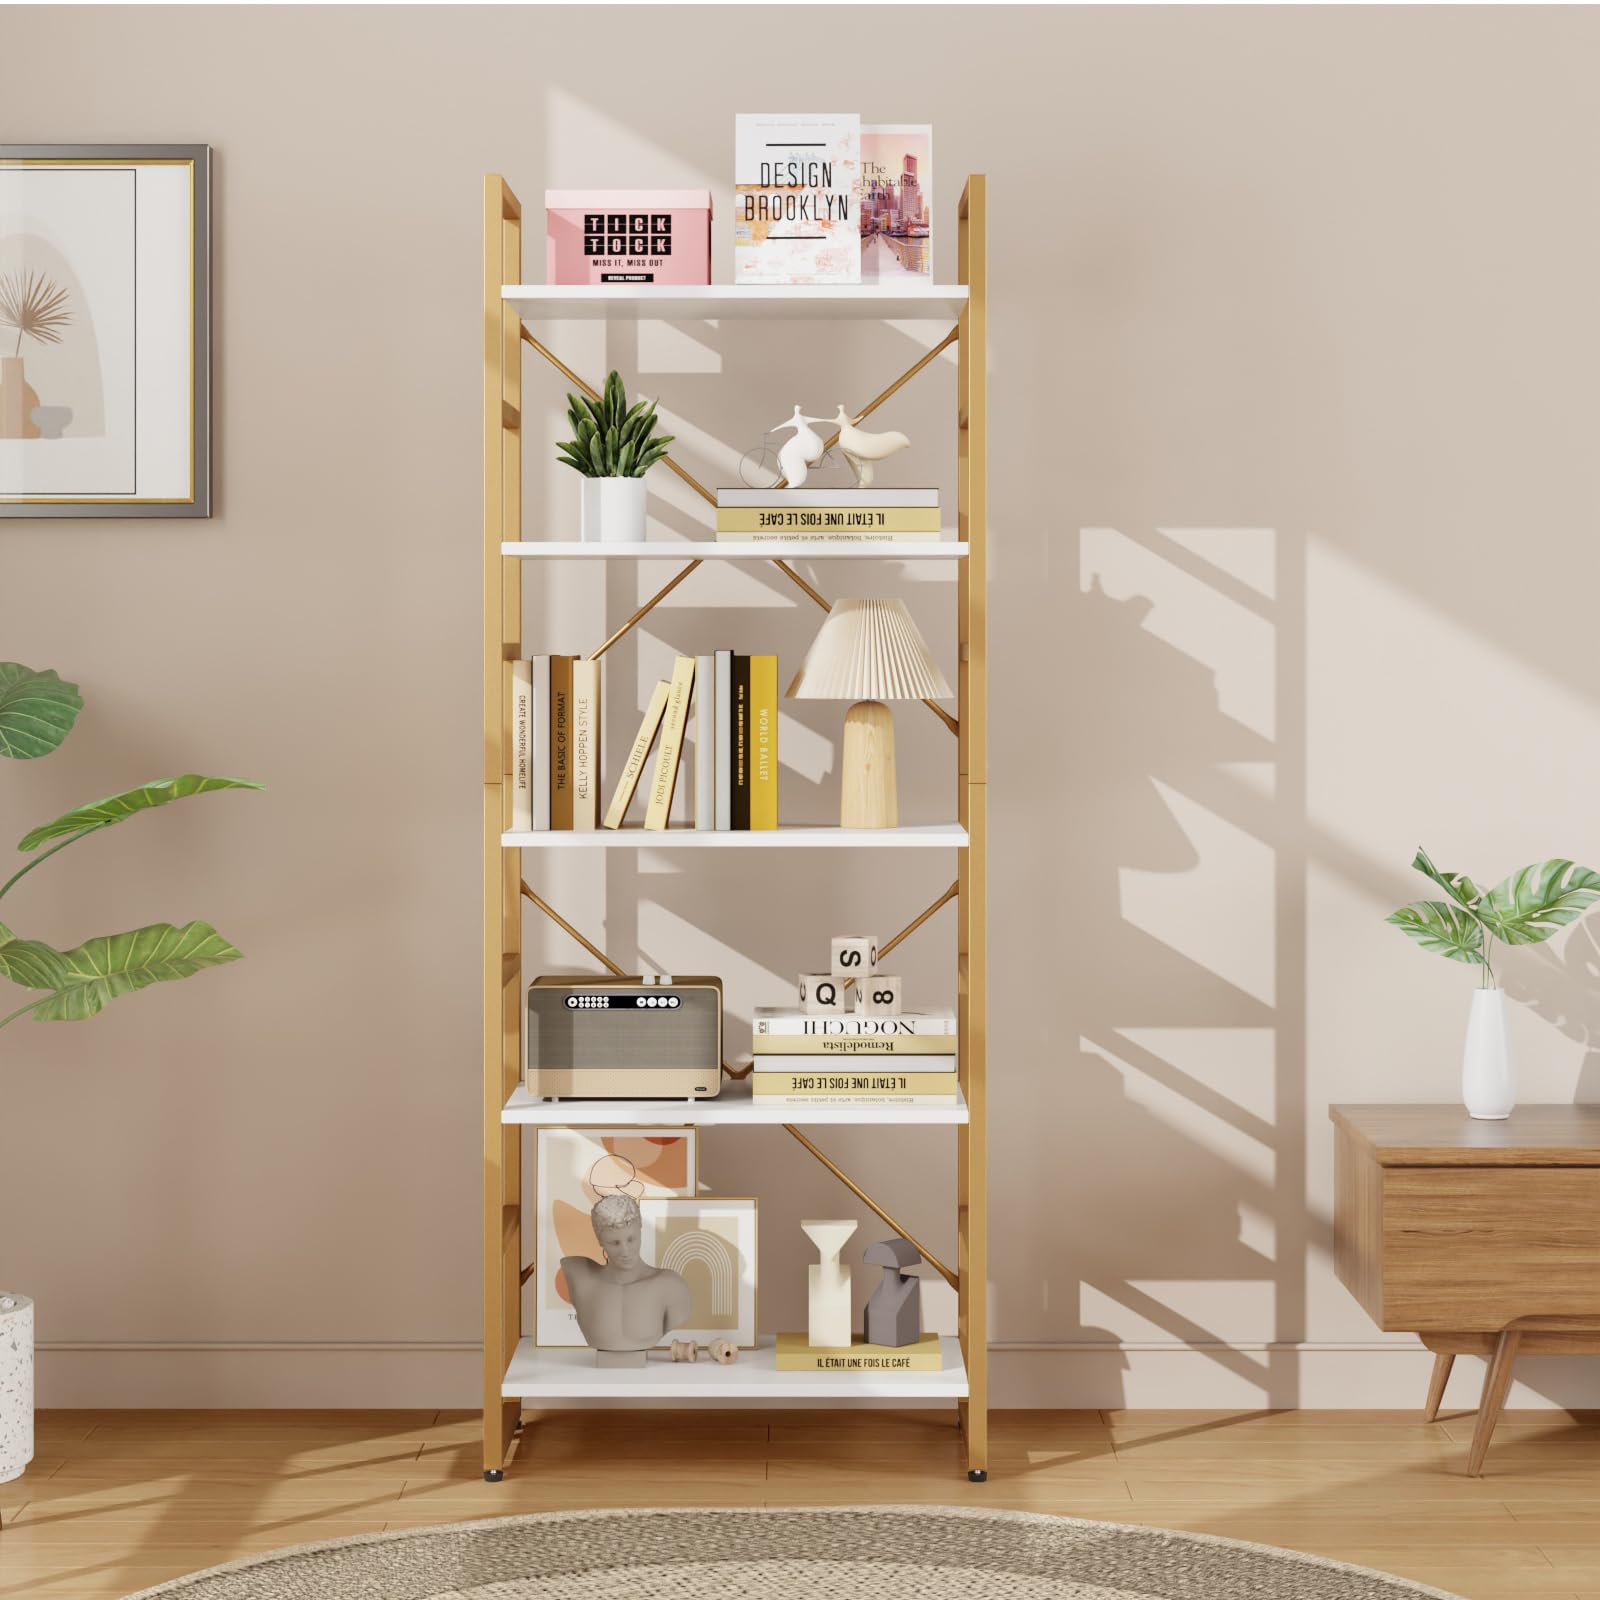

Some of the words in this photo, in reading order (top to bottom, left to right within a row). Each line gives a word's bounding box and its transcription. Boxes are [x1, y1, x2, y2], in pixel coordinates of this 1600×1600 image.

[760, 162, 833, 188] DESIGN
[860, 161, 886, 174] The
[744, 194, 849, 222] BROOKLYN
[589, 216, 667, 233] TICK
[589, 237, 667, 254] TOCK
[592, 259, 612, 267] MISS
[614, 259, 624, 268] IT,
[627, 259, 646, 267] MISS
[649, 259, 664, 267] OUT
[759, 513, 784, 528] CAFÉ
[786, 513, 798, 526] LE
[800, 513, 822, 526] FOIS
[824, 513, 844, 526] UNE
[846, 513, 873, 528] ÉTAIT
[876, 513, 885, 526] IL
[518, 695, 526, 718] CREATE
[557, 691, 566, 728] FORMAT
[578, 698, 588, 726] STYLE
[760, 708, 768, 743] WORLD
[518, 720, 526, 758] WONDERFUL
[557, 731, 566, 742] OF
[579, 730, 588, 768] HOPPEN
[557, 745, 566, 770] BASIC
[626, 736, 648, 779] SCHIELE
[760, 747, 768, 781] BALLET
[518, 759, 526, 790] HOMELIFE
[557, 772, 566, 790] THE
[579, 771, 588, 799] KELLY
[654, 784, 666, 806] JODI
[840, 950, 861, 968] S
[816, 982, 836, 1006] Q
[873, 990, 894, 1004] 8
[804, 1020, 916, 1035] NOGUCHI
[822, 1041, 894, 1052] Remodelista
[792, 1077, 814, 1092] CAFÉ
[816, 1077, 826, 1089] LE
[829, 1077, 848, 1089] FOIS
[852, 1077, 868, 1089] UNE
[871, 1077, 895, 1092] ÉTAIT
[898, 1077, 906, 1089] IL
[817, 1358, 824, 1368] IL
[826, 1357, 845, 1368] ÉTAIT
[847, 1358, 862, 1368] UNE
[864, 1358, 880, 1368] FOIS
[882, 1358, 890, 1368] LE
[892, 1357, 910, 1368] CAFÉ
